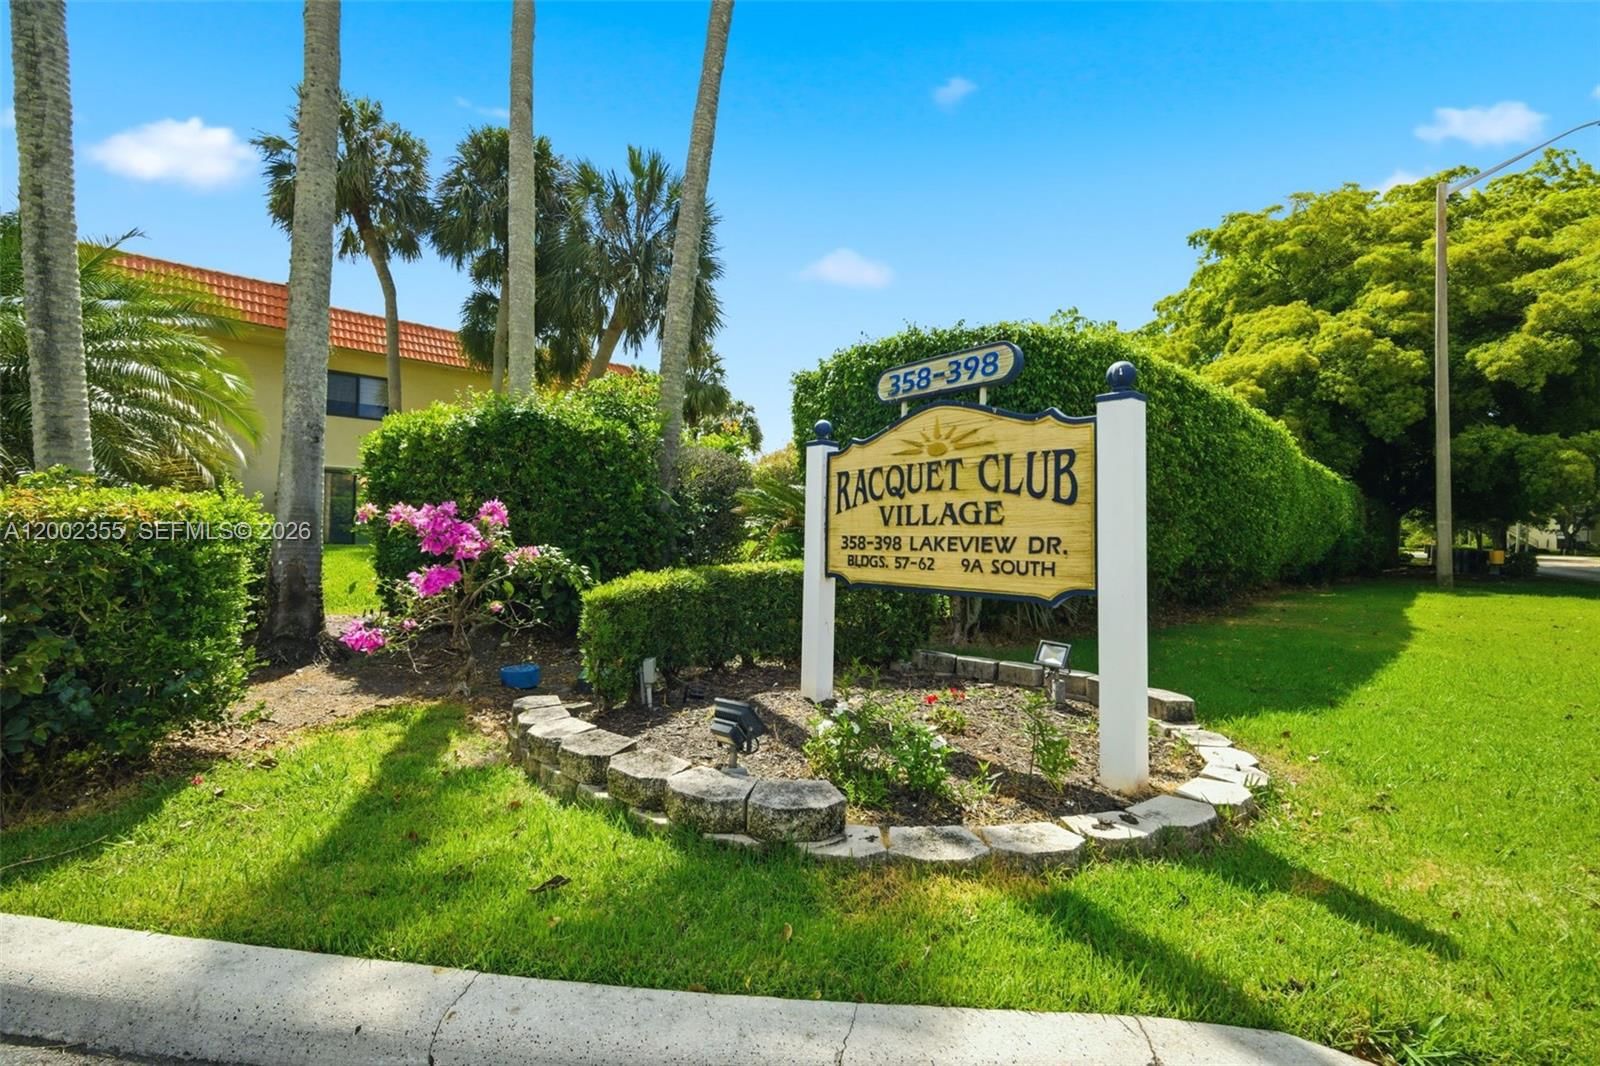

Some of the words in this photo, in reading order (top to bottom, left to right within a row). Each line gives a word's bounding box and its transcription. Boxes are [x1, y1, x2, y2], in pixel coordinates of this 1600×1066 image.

[887, 351, 1000, 397] 358-398
[835, 457, 963, 516] RACQUET
[978, 449, 1079, 505] CLUB
[879, 501, 1006, 527] VILLAGE
[841, 536, 902, 551] 358-398
[909, 536, 1017, 554] LAKEVIEW
[1028, 536, 1069, 556] DR.
[847, 555, 889, 569] BLDGS.
[894, 557, 935, 571] 57-62
[961, 559, 984, 574] 9A
[991, 559, 1056, 577] SOUTH
